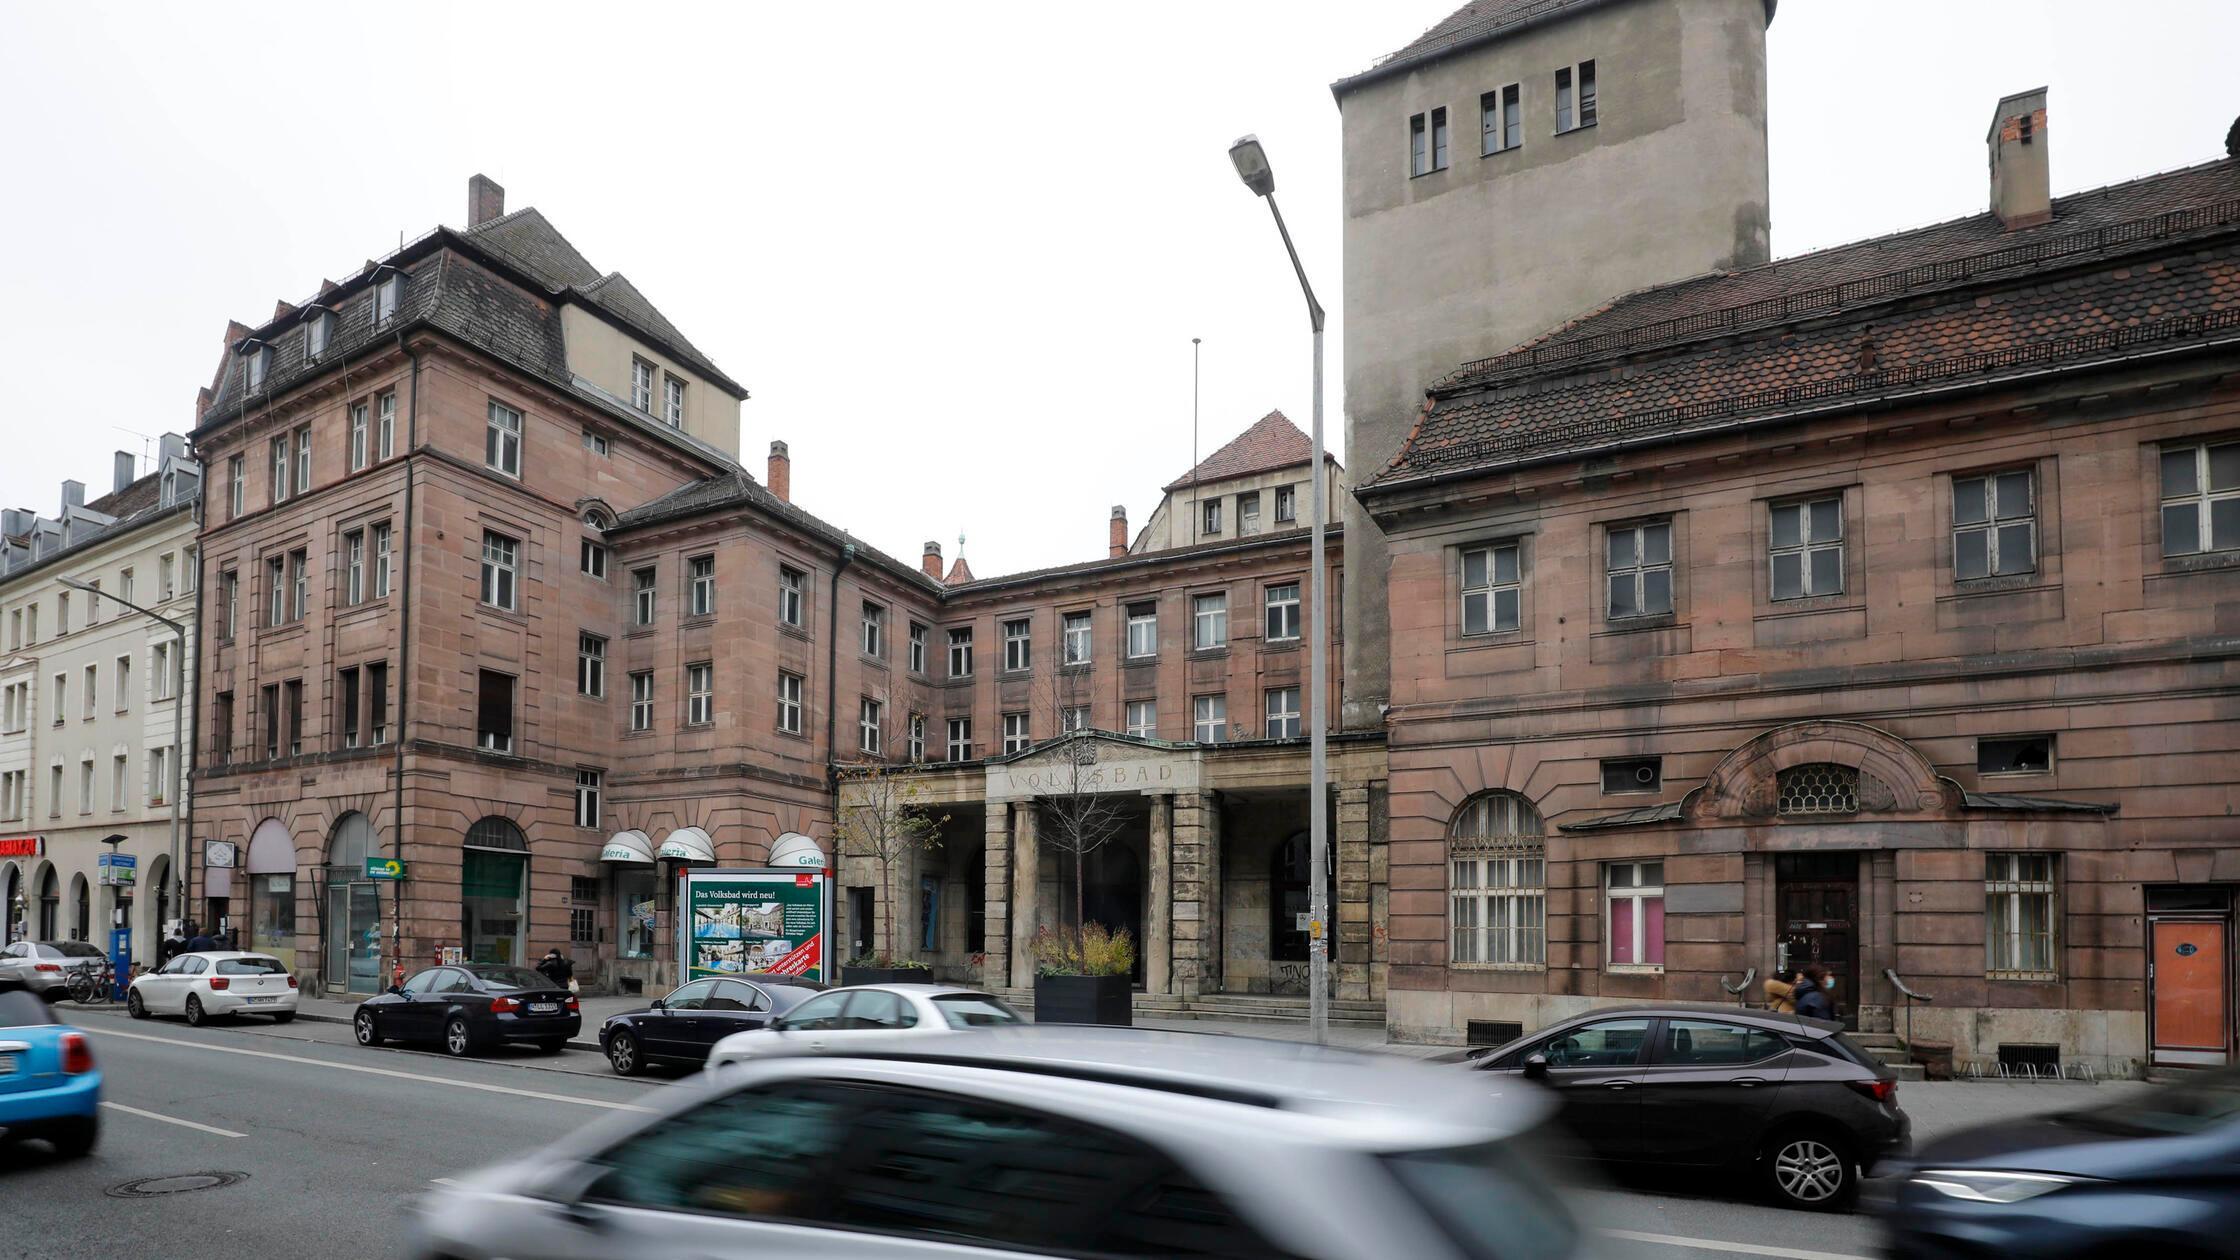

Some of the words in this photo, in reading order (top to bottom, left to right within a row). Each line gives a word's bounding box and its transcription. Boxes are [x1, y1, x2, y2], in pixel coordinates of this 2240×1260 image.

[695, 890, 708, 899] Das
[709, 890, 740, 899] Volksbad
[742, 890, 758, 899] wird
[759, 891, 776, 899] neu!
